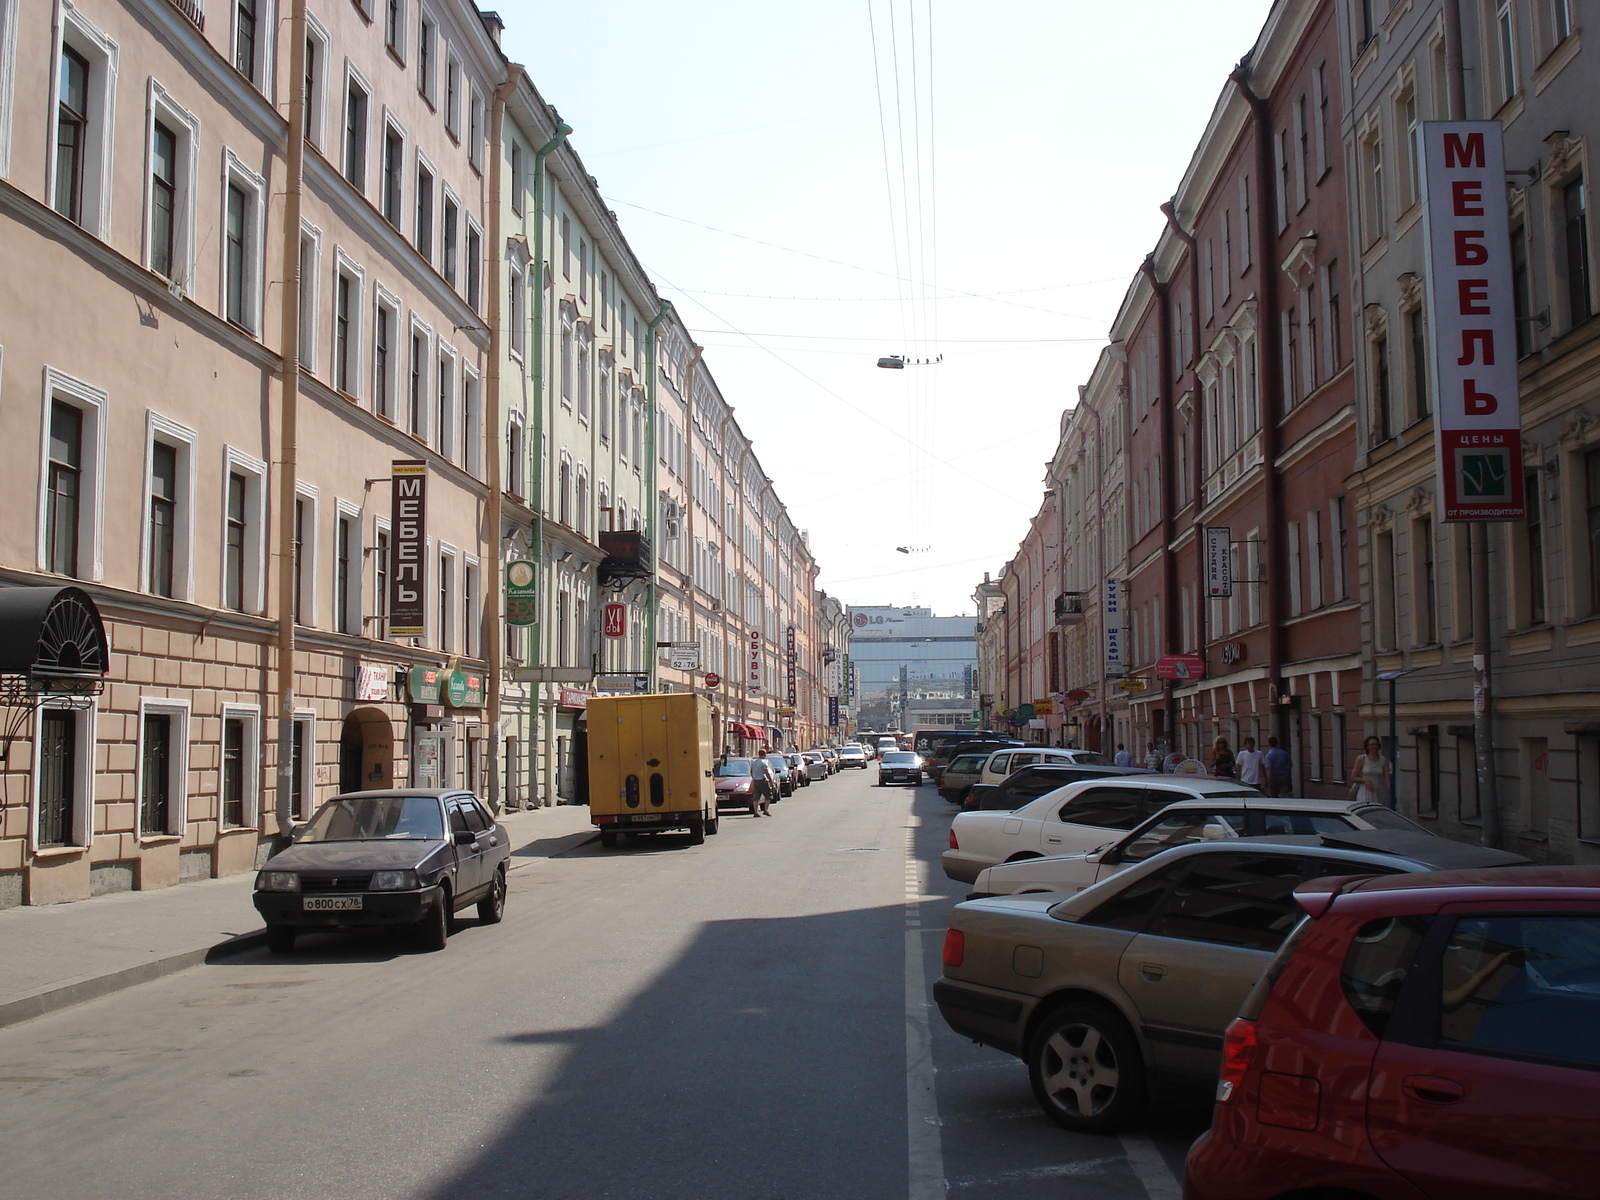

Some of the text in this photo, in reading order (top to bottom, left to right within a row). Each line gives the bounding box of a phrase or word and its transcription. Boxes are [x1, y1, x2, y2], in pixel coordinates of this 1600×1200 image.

[1443, 132, 1499, 416] МЕБЕЛЬ
[1460, 435, 1504, 445] ЦЕНЫ
[1460, 508, 1524, 516] ПРОИЗВОДИТЕЛЯ
[396, 478, 421, 603] МЕБЕЛЬ
[1221, 548, 1229, 595] КРАСОТЫ
[507, 599, 535, 615] SEX
[1107, 579, 1117, 612] КУХНИ
[869, 615, 884, 624] LG
[751, 631, 759, 680] ОБУВЬ
[1108, 628, 1119, 660] ШКАФЫ
[349, 898, 359, 906] 78
